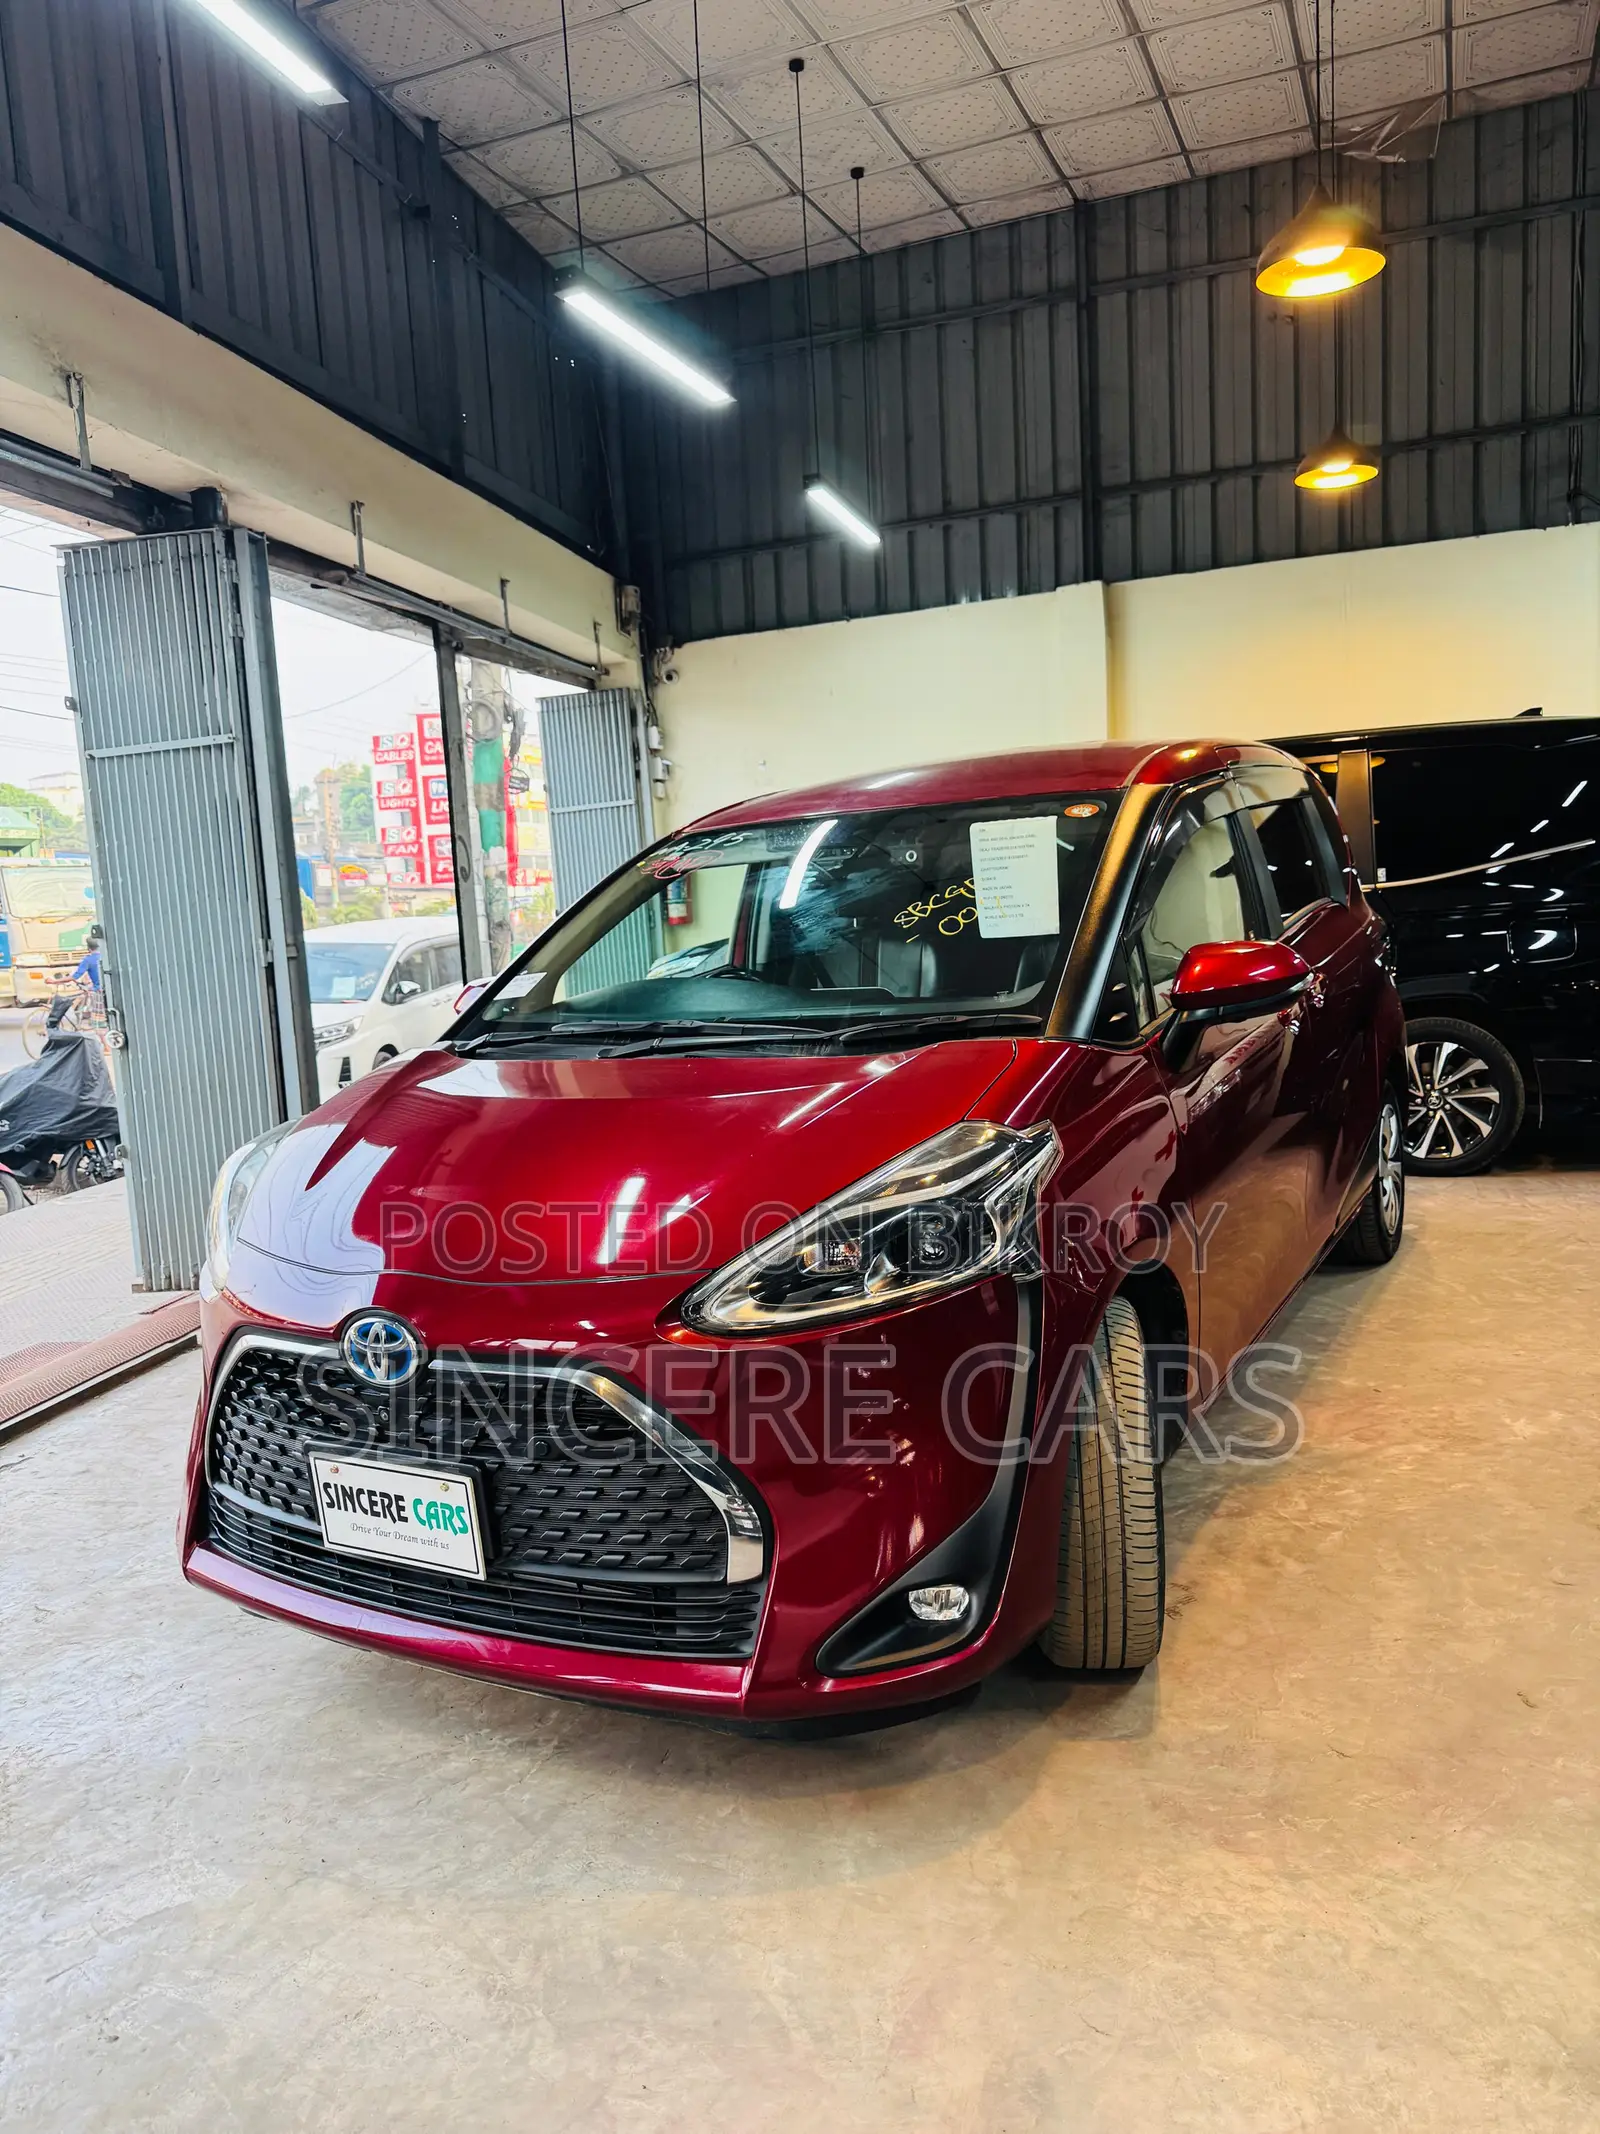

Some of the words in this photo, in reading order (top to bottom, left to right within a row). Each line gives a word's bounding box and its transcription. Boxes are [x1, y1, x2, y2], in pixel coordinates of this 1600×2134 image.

[375, 749, 415, 762] CABLES
[380, 798, 417, 809] LIGHTS
[387, 844, 419, 854] FAN
[322, 1481, 409, 1524] SINCERE
[412, 1498, 469, 1536] CARS
[350, 1522, 372, 1534] Drive
[373, 1527, 391, 1538] Your
[393, 1531, 418, 1544] Dream
[420, 1537, 439, 1548] with
[440, 1542, 450, 1550] us
